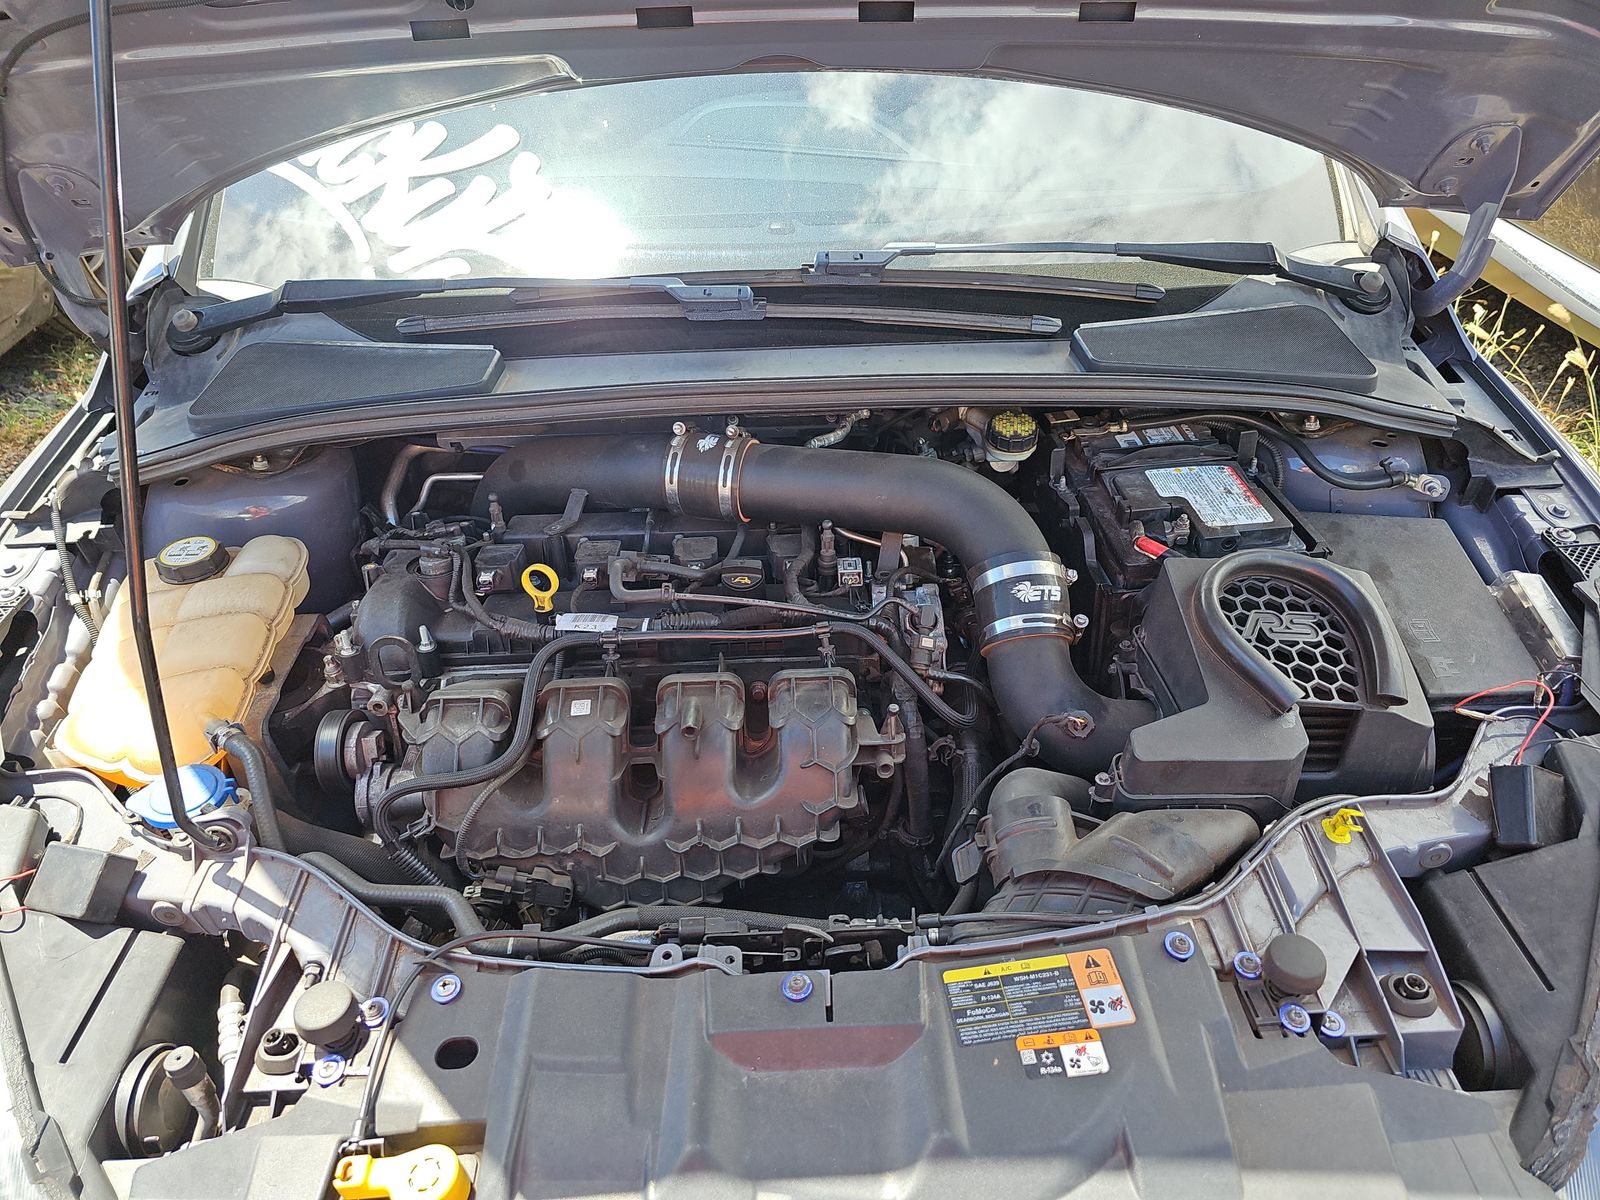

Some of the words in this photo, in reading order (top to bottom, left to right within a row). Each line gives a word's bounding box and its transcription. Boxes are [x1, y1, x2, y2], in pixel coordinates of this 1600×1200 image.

[1029, 585, 1062, 602] ETS
[1242, 610, 1322, 642] RS
[974, 981, 987, 989] SAE
[966, 1006, 997, 1016] FoMoCo
